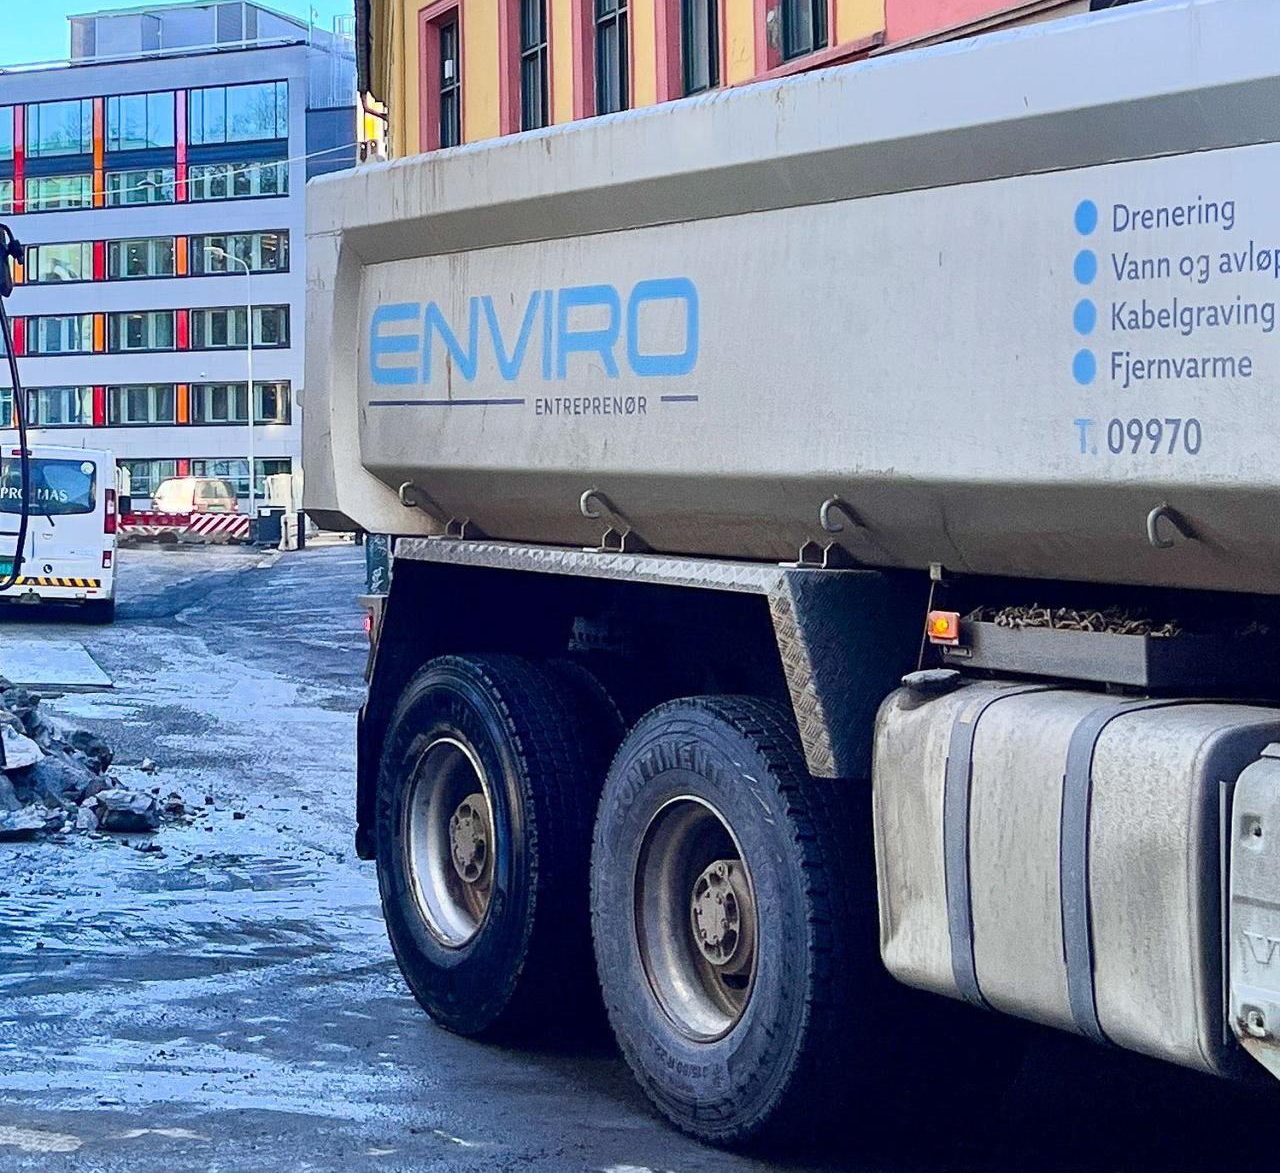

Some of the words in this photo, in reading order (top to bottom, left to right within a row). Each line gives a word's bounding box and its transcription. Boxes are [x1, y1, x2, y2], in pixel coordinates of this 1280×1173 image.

[1112, 195, 1236, 232] Drenering
[1111, 252, 1171, 281] Vann
[1179, 254, 1210, 284] og
[370, 277, 699, 386] ENVIRO
[1111, 295, 1275, 336] Kabelgraving
[1110, 351, 1253, 389] Fjernvarme
[535, 396, 647, 415] ENTREPRENØR
[1107, 418, 1202, 455] 09970
